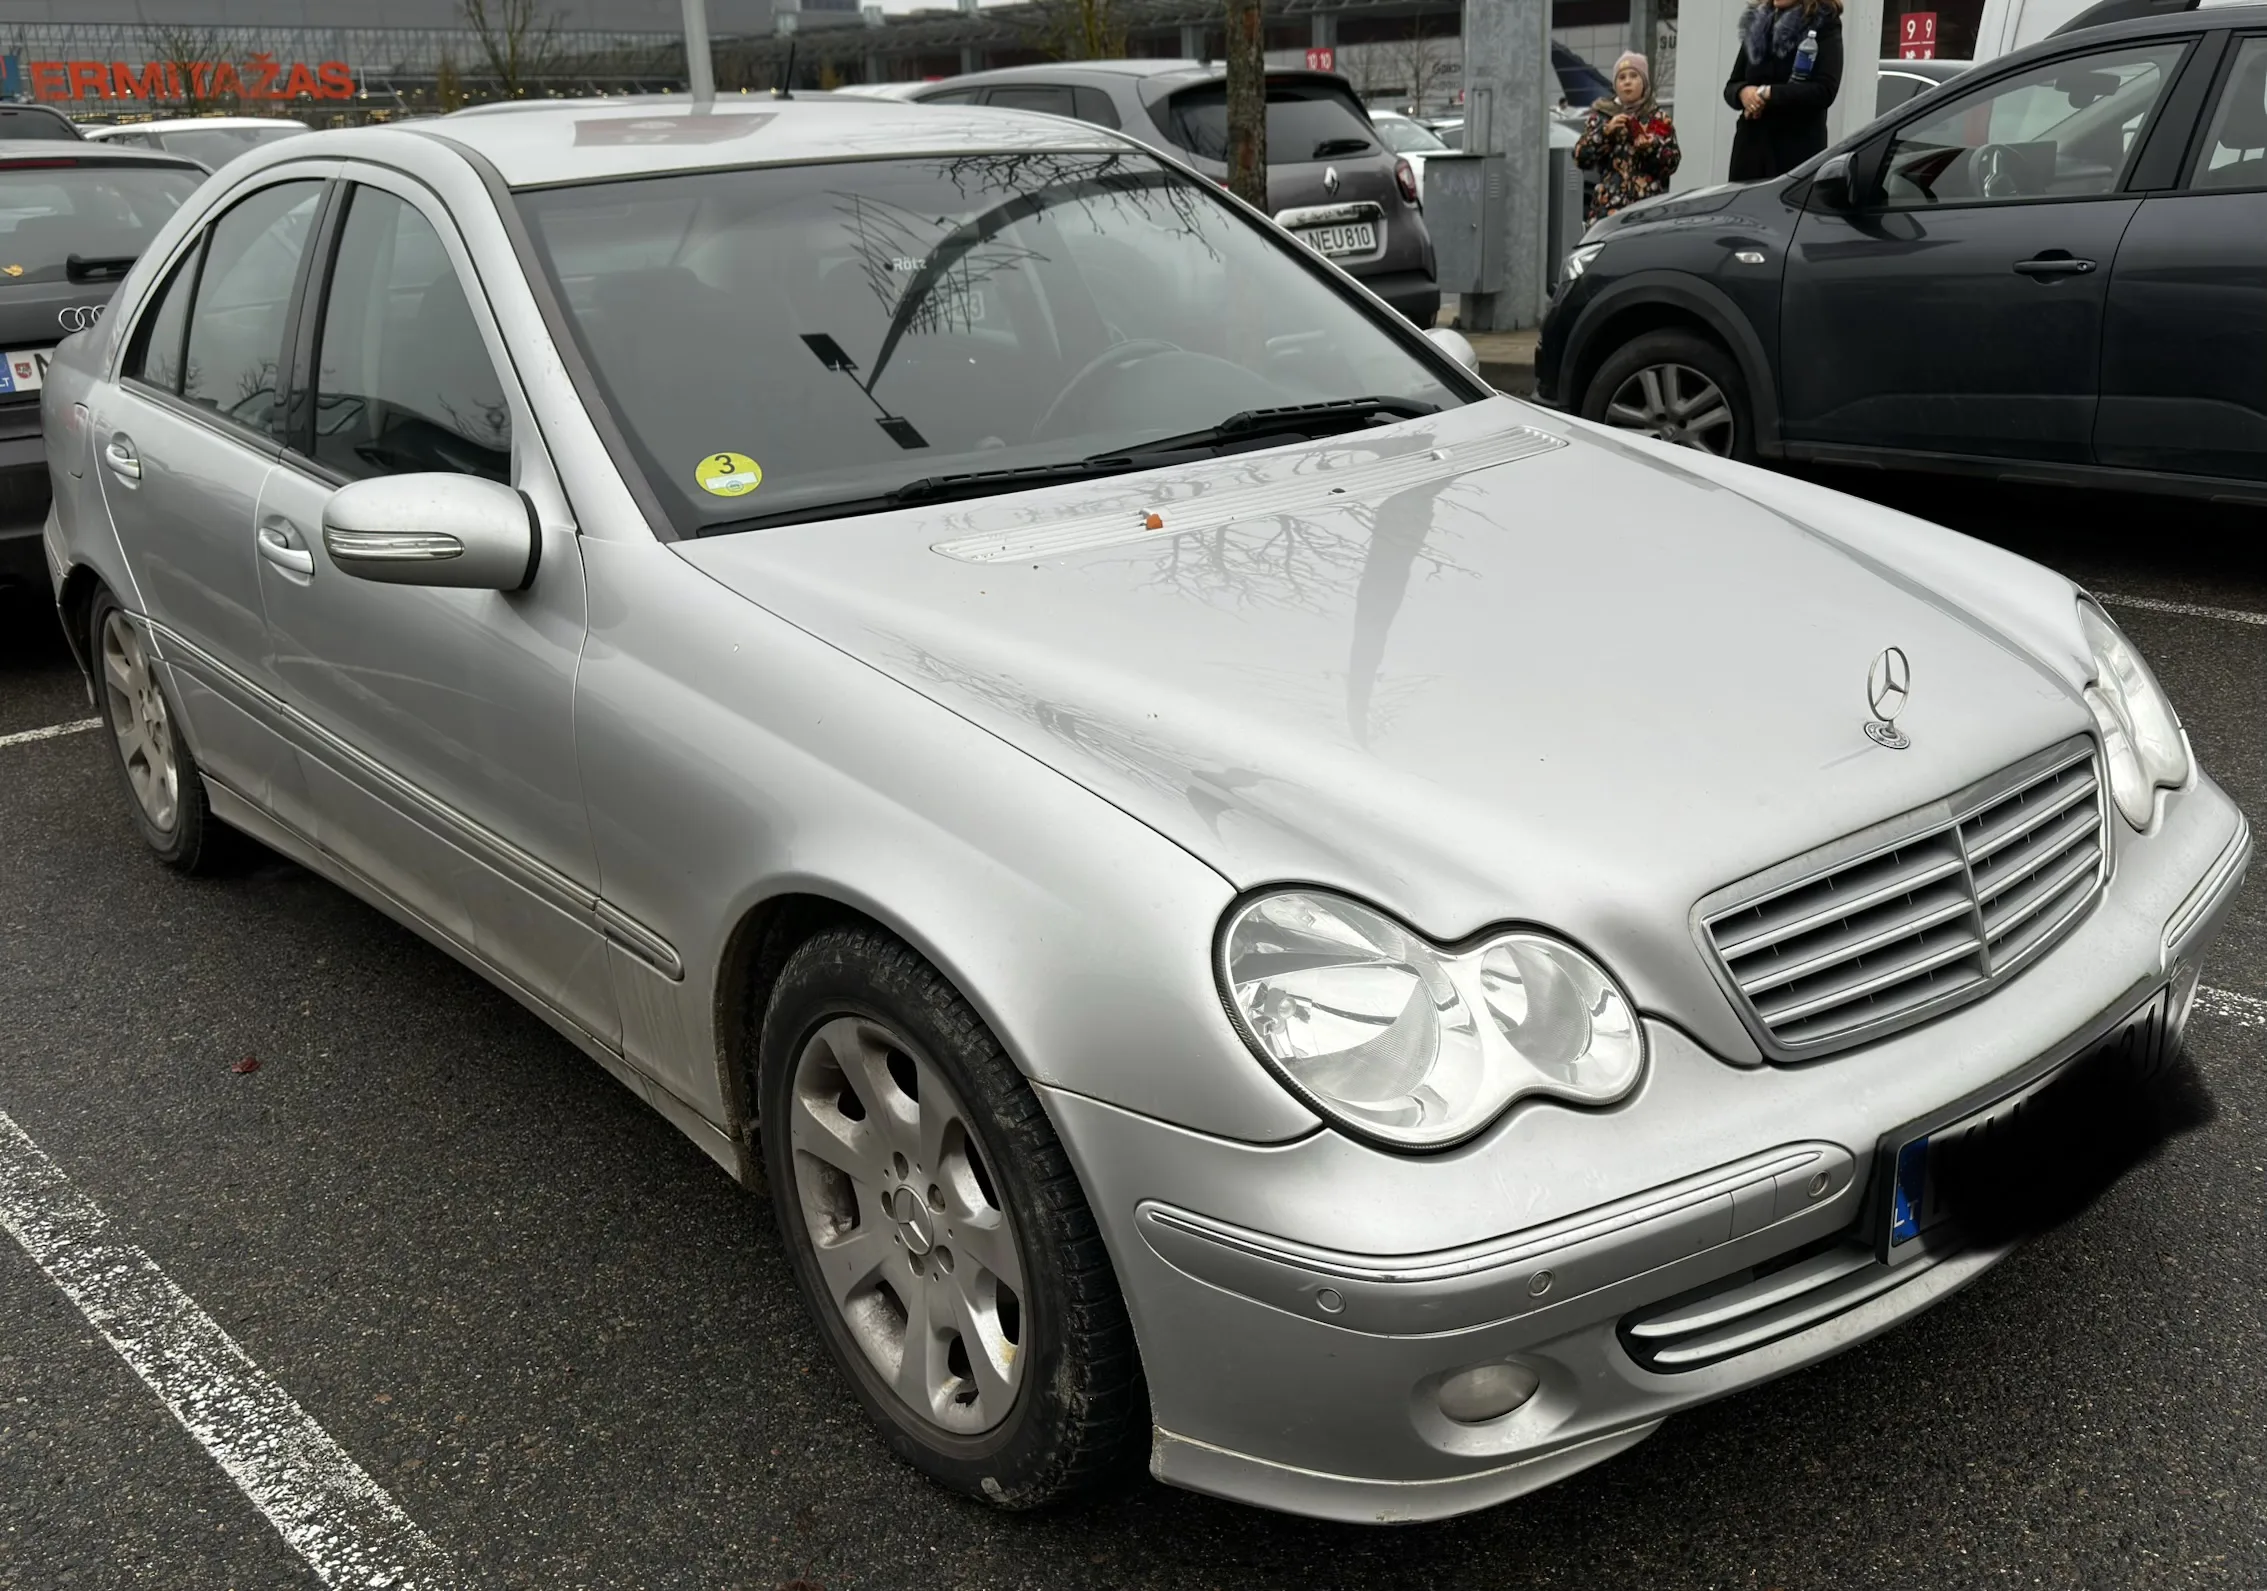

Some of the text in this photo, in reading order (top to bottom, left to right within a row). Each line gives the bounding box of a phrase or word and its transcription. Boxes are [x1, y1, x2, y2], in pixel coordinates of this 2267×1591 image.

[1906, 18, 1933, 40] 9 9
[30, 51, 356, 100] ERMITAŽAS
[1308, 226, 1371, 250] NEU810
[714, 454, 735, 475] 3
[1893, 1200, 1919, 1228] LT
